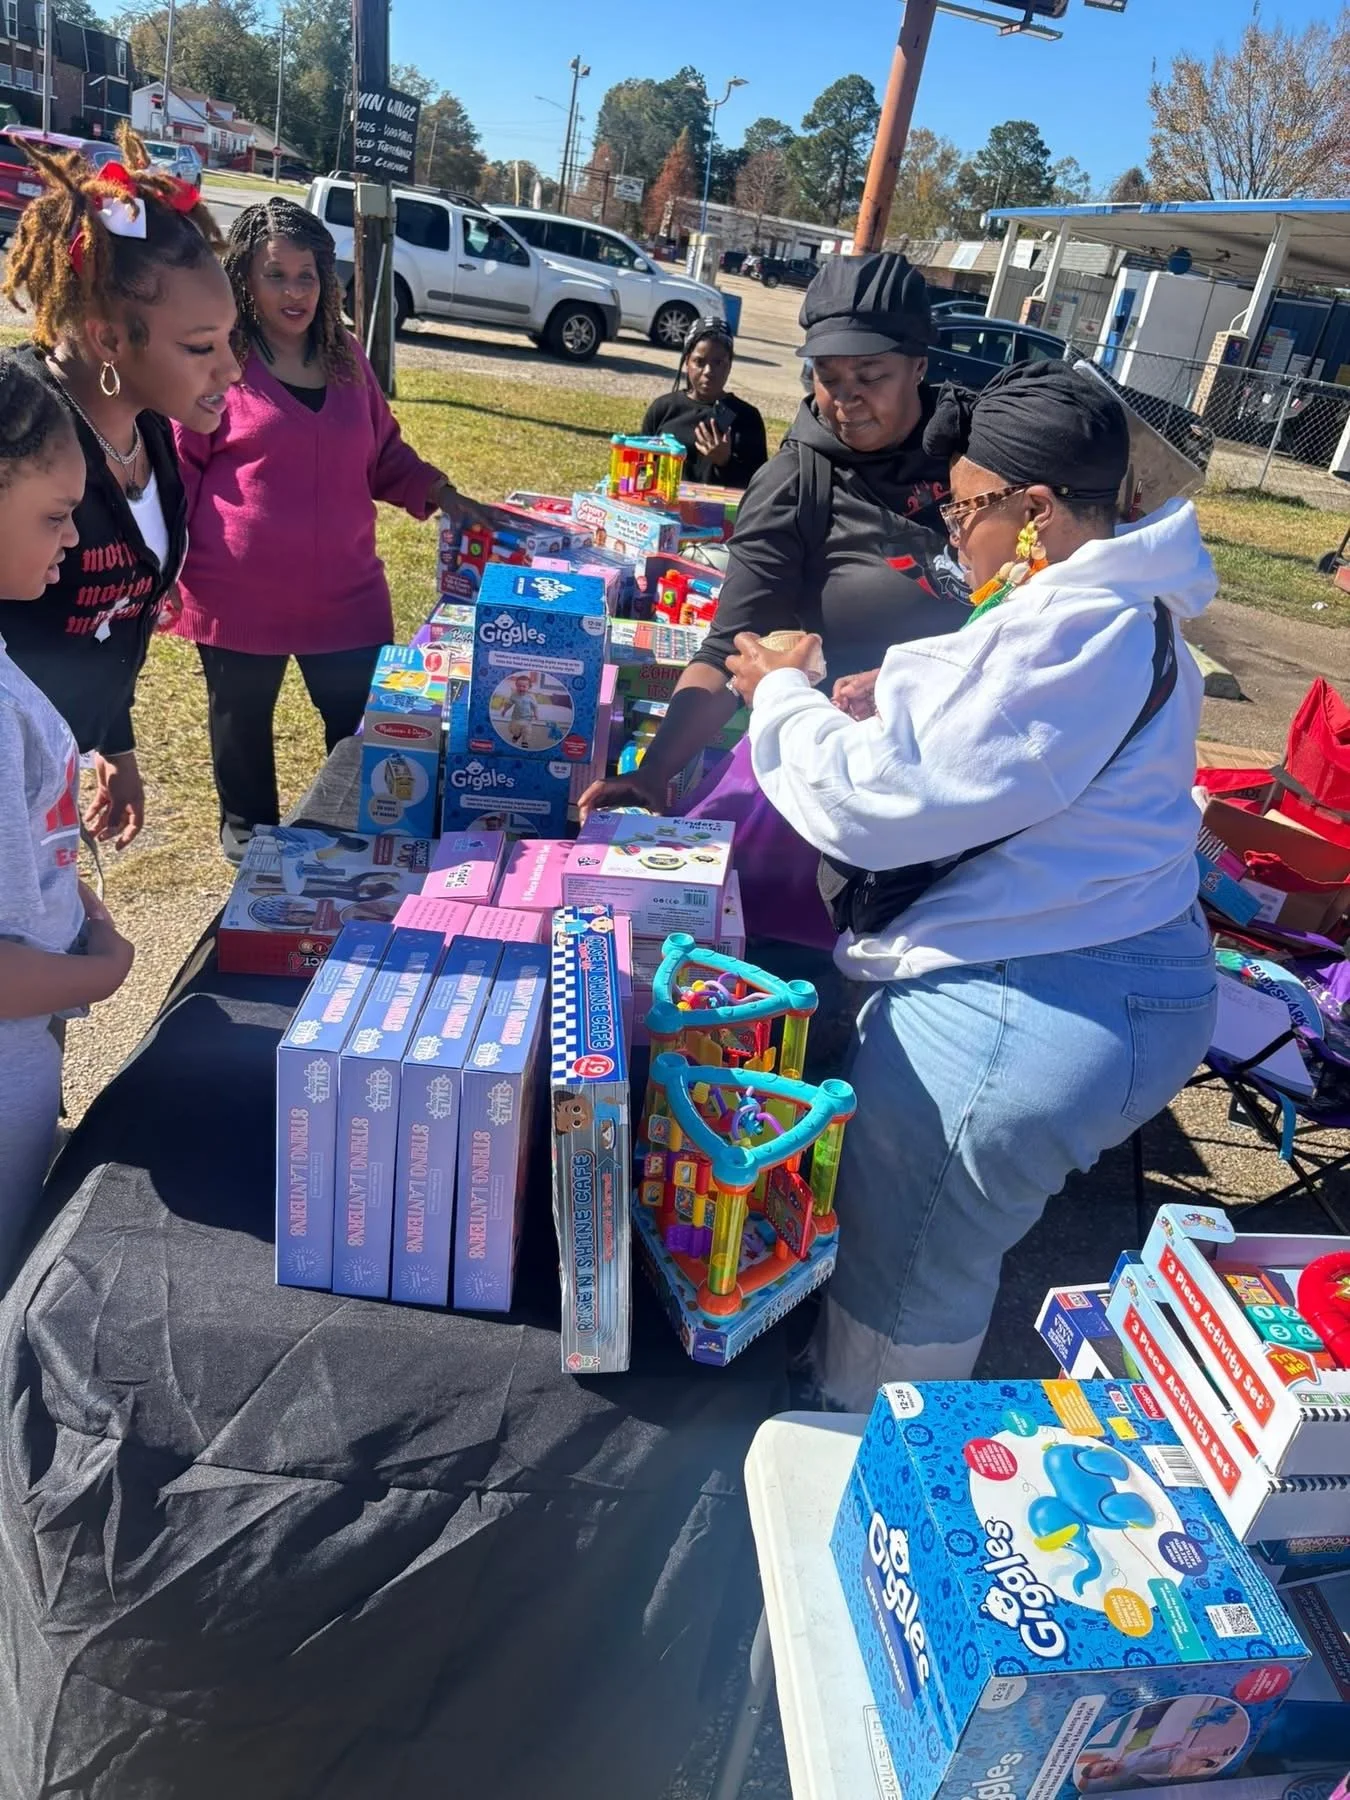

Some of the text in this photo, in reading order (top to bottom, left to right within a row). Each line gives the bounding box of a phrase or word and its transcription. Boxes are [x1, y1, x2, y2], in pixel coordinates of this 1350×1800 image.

[480, 622, 547, 648] Giggles
[451, 768, 516, 791] Giggles
[587, 937, 612, 1049] RISE N SHINE CAFE
[1249, 964, 1311, 1027] BABY SHARK
[317, 1065, 330, 1097] STYLE
[590, 1060, 608, 1073] 19
[378, 1074, 391, 1106] STYLE
[439, 1082, 451, 1114] STYLE
[500, 1087, 513, 1120] STYLE
[289, 1108, 308, 1237] STRING LANTERNS
[470, 1131, 491, 1185] STRING
[650, 1156, 662, 1172] B
[346, 1117, 370, 1246] STRING LANTERNS
[406, 1123, 430, 1253] STRING LANTERNS
[468, 1187, 489, 1260] LANTERNS
[571, 1154, 595, 1333] RISE N SHINE CAFE
[1262, 1306, 1269, 1318] 1
[1289, 1307, 1298, 1319] 2
[1167, 1263, 1265, 1410] 3 Piece Activity Set
[1275, 1326, 1286, 1339] 3
[1302, 1325, 1314, 1340] 4
[1271, 1350, 1296, 1370] Try
[1284, 1361, 1309, 1377] Me!
[895, 1389, 910, 1410] 12-36
[1130, 1320, 1231, 1481] 3 Piece Activity Set
[867, 1511, 931, 1688] Giggles
[984, 1519, 1067, 1659] Giggles
[884, 1635, 905, 1691] ELEPHANT
